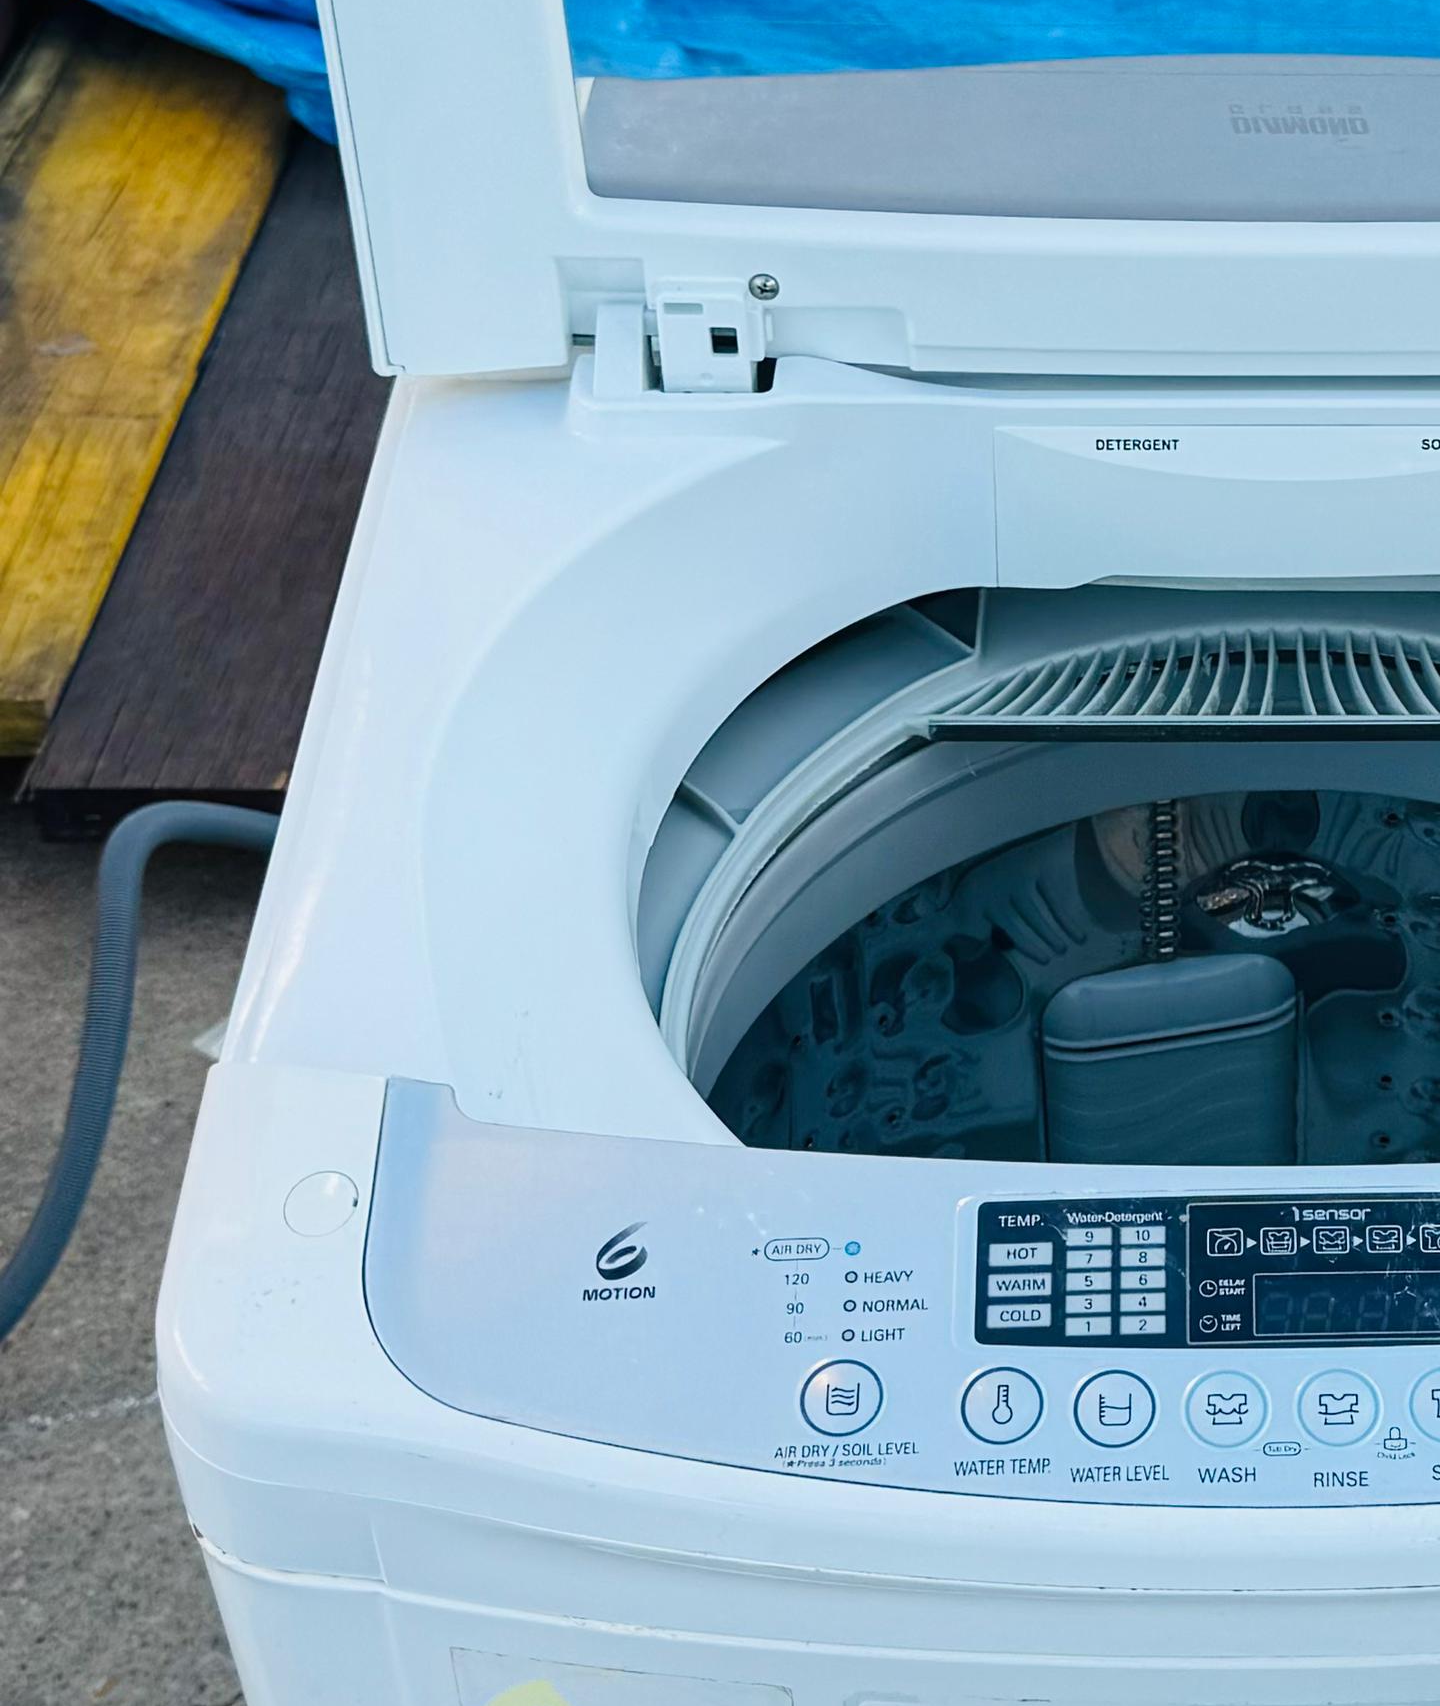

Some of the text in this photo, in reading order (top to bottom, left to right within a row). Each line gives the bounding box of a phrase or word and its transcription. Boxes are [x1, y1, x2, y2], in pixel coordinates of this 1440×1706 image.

[1096, 439, 1179, 451] DETERGENT
[999, 1215, 1044, 1227] TEMP.
[1085, 1231, 1093, 1242] 9
[1136, 1229, 1149, 1241] 10
[772, 1244, 821, 1255] AIR DRY
[1007, 1248, 1037, 1259] HOT
[1086, 1254, 1093, 1264] 7
[1139, 1252, 1147, 1263] 8
[784, 1273, 809, 1285] 120
[864, 1270, 913, 1284] HEAVY
[1084, 1276, 1093, 1287] 5
[1139, 1274, 1147, 1285] 6
[996, 1279, 1045, 1291] WARM
[1219, 1287, 1245, 1295] START
[582, 1286, 655, 1301] MOTION
[787, 1302, 804, 1314] 90
[862, 1299, 928, 1312] NORMAL
[1084, 1299, 1092, 1310] 3
[1138, 1297, 1147, 1307] 4
[1000, 1310, 1041, 1322] COLD
[1086, 1321, 1090, 1332] 1
[1139, 1320, 1147, 1331] 2
[1221, 1323, 1241, 1331] LEFT
[784, 1331, 802, 1344] 60
[861, 1328, 905, 1342] LIGHT
[774, 1446, 796, 1459] AIR
[802, 1445, 829, 1458] DRY
[842, 1443, 873, 1456] SOIL
[878, 1442, 918, 1455] LEVEL
[954, 1458, 1051, 1477] WATER TEMP.
[1071, 1465, 1169, 1483] WATER LEVEL
[1198, 1467, 1256, 1483] WASH
[1313, 1471, 1369, 1488] RINSE
